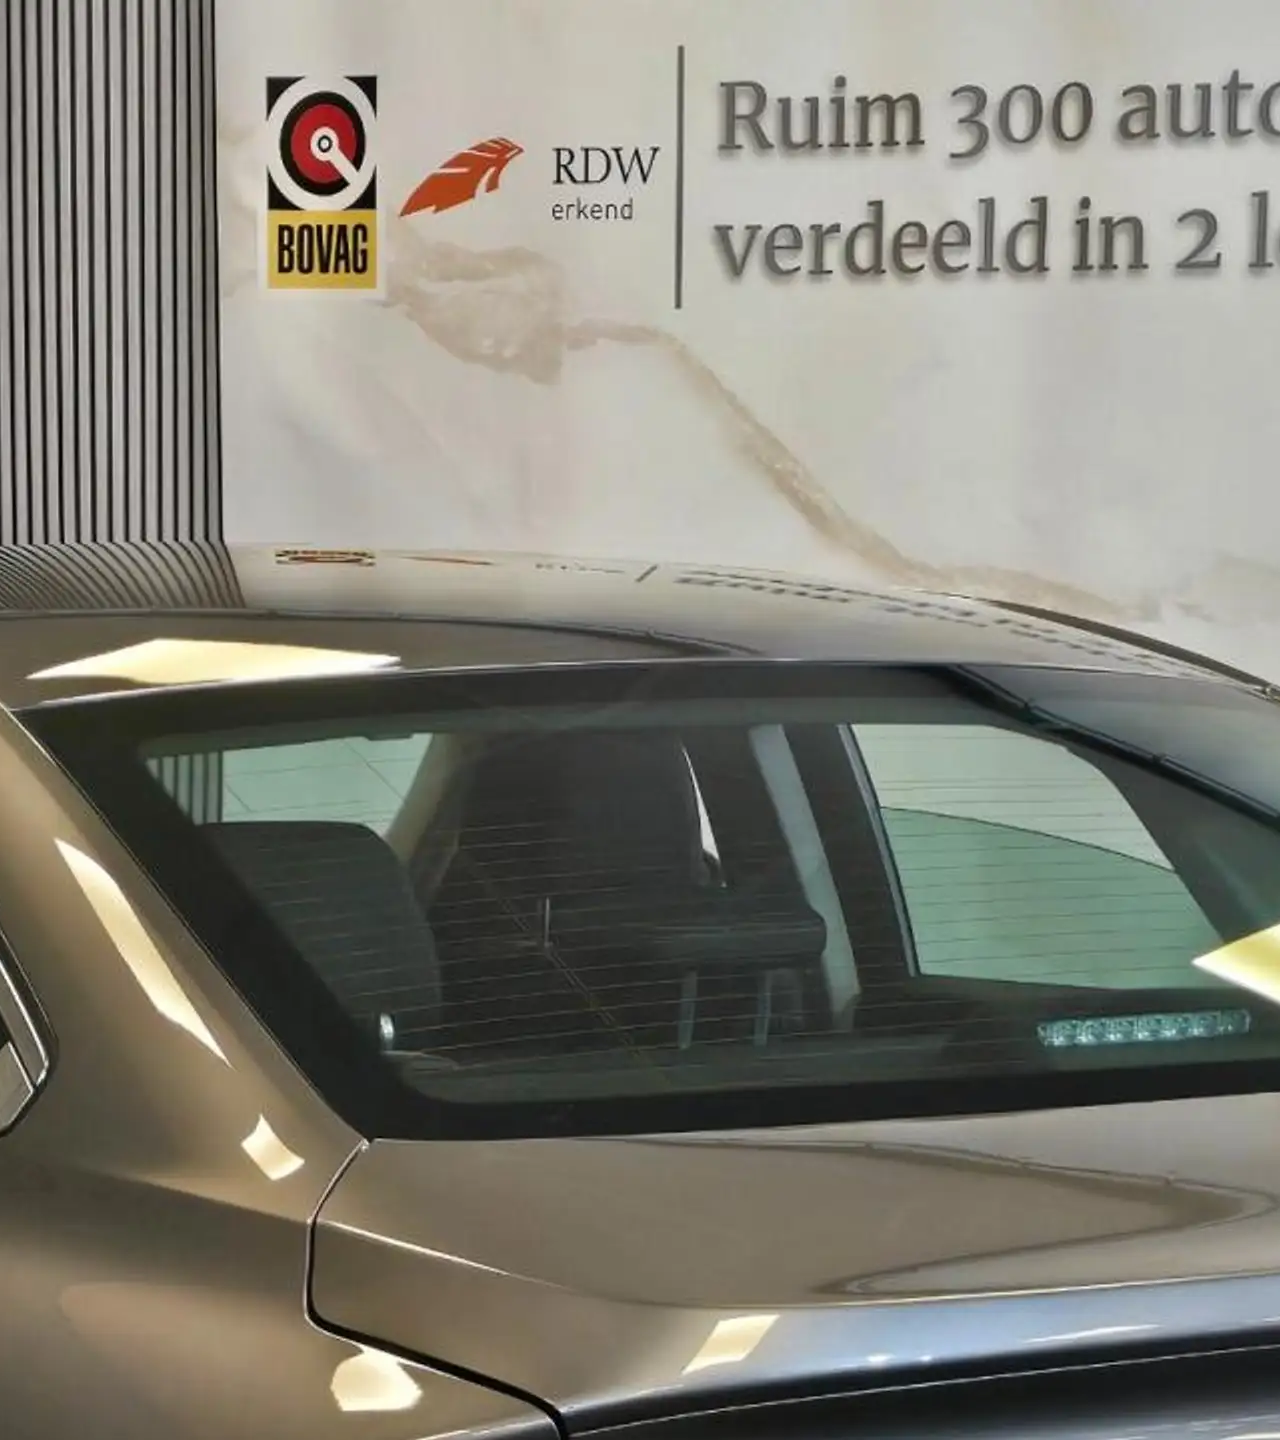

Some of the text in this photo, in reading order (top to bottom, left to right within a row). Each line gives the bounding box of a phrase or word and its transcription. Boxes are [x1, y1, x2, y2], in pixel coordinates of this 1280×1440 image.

[717, 74, 926, 151] Ruim
[948, 80, 1095, 160] 300
[551, 146, 661, 185] RDW
[551, 197, 634, 221] erkend
[276, 222, 369, 275] BOVAG
[713, 196, 1051, 278] verdeeld
[1073, 196, 1150, 272] in
[1173, 207, 1224, 270] 2
